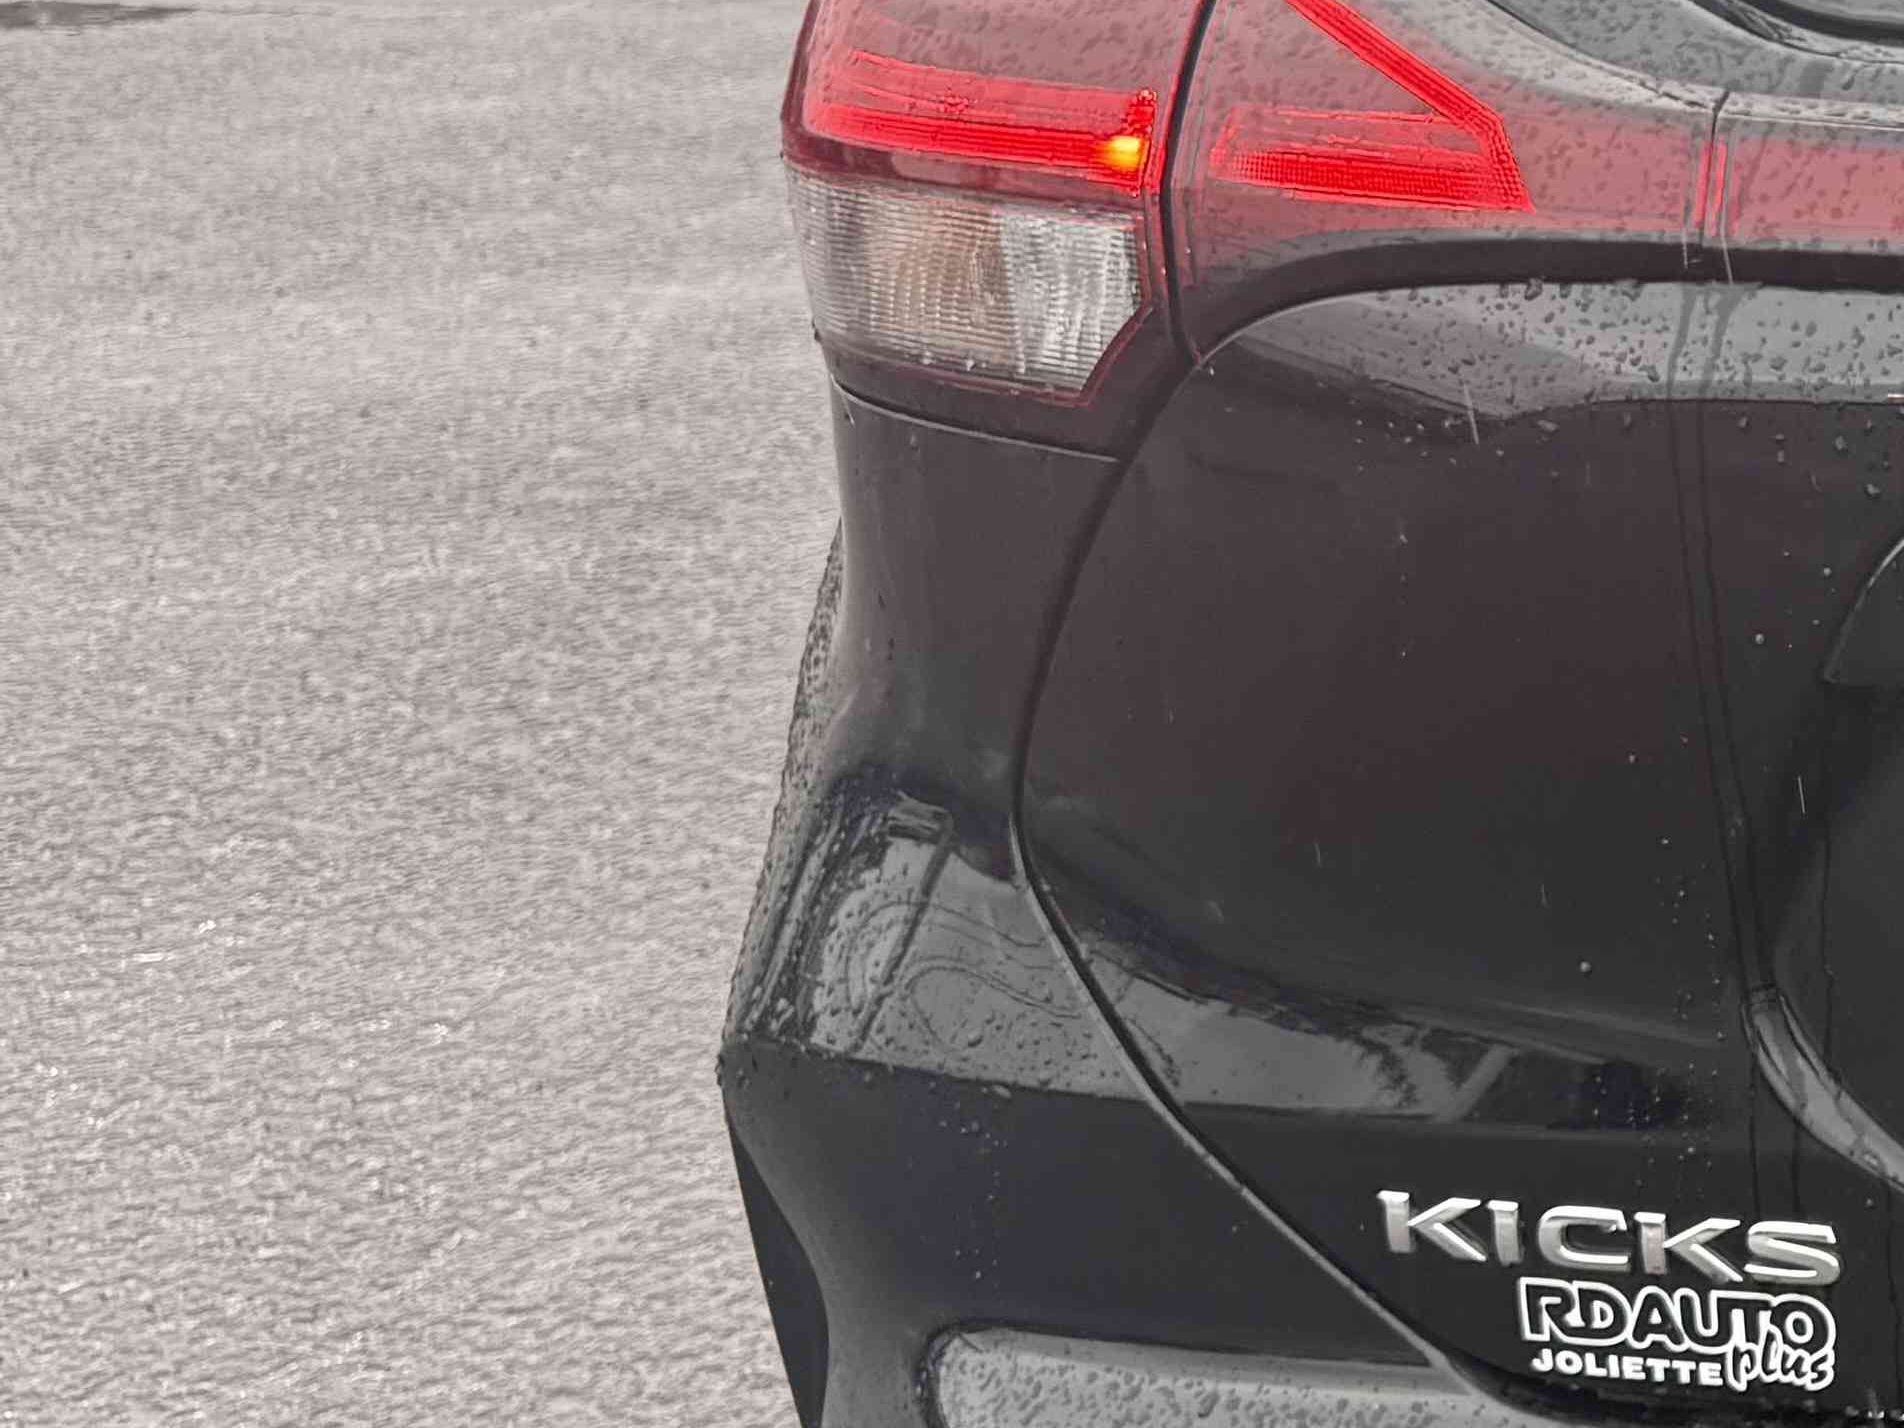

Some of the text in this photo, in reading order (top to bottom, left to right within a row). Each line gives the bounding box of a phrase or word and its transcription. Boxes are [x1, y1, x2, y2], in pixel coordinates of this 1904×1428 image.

[1376, 1189, 1842, 1286] KICKS
[1532, 1316, 1835, 1392] JOLIETTE plus
